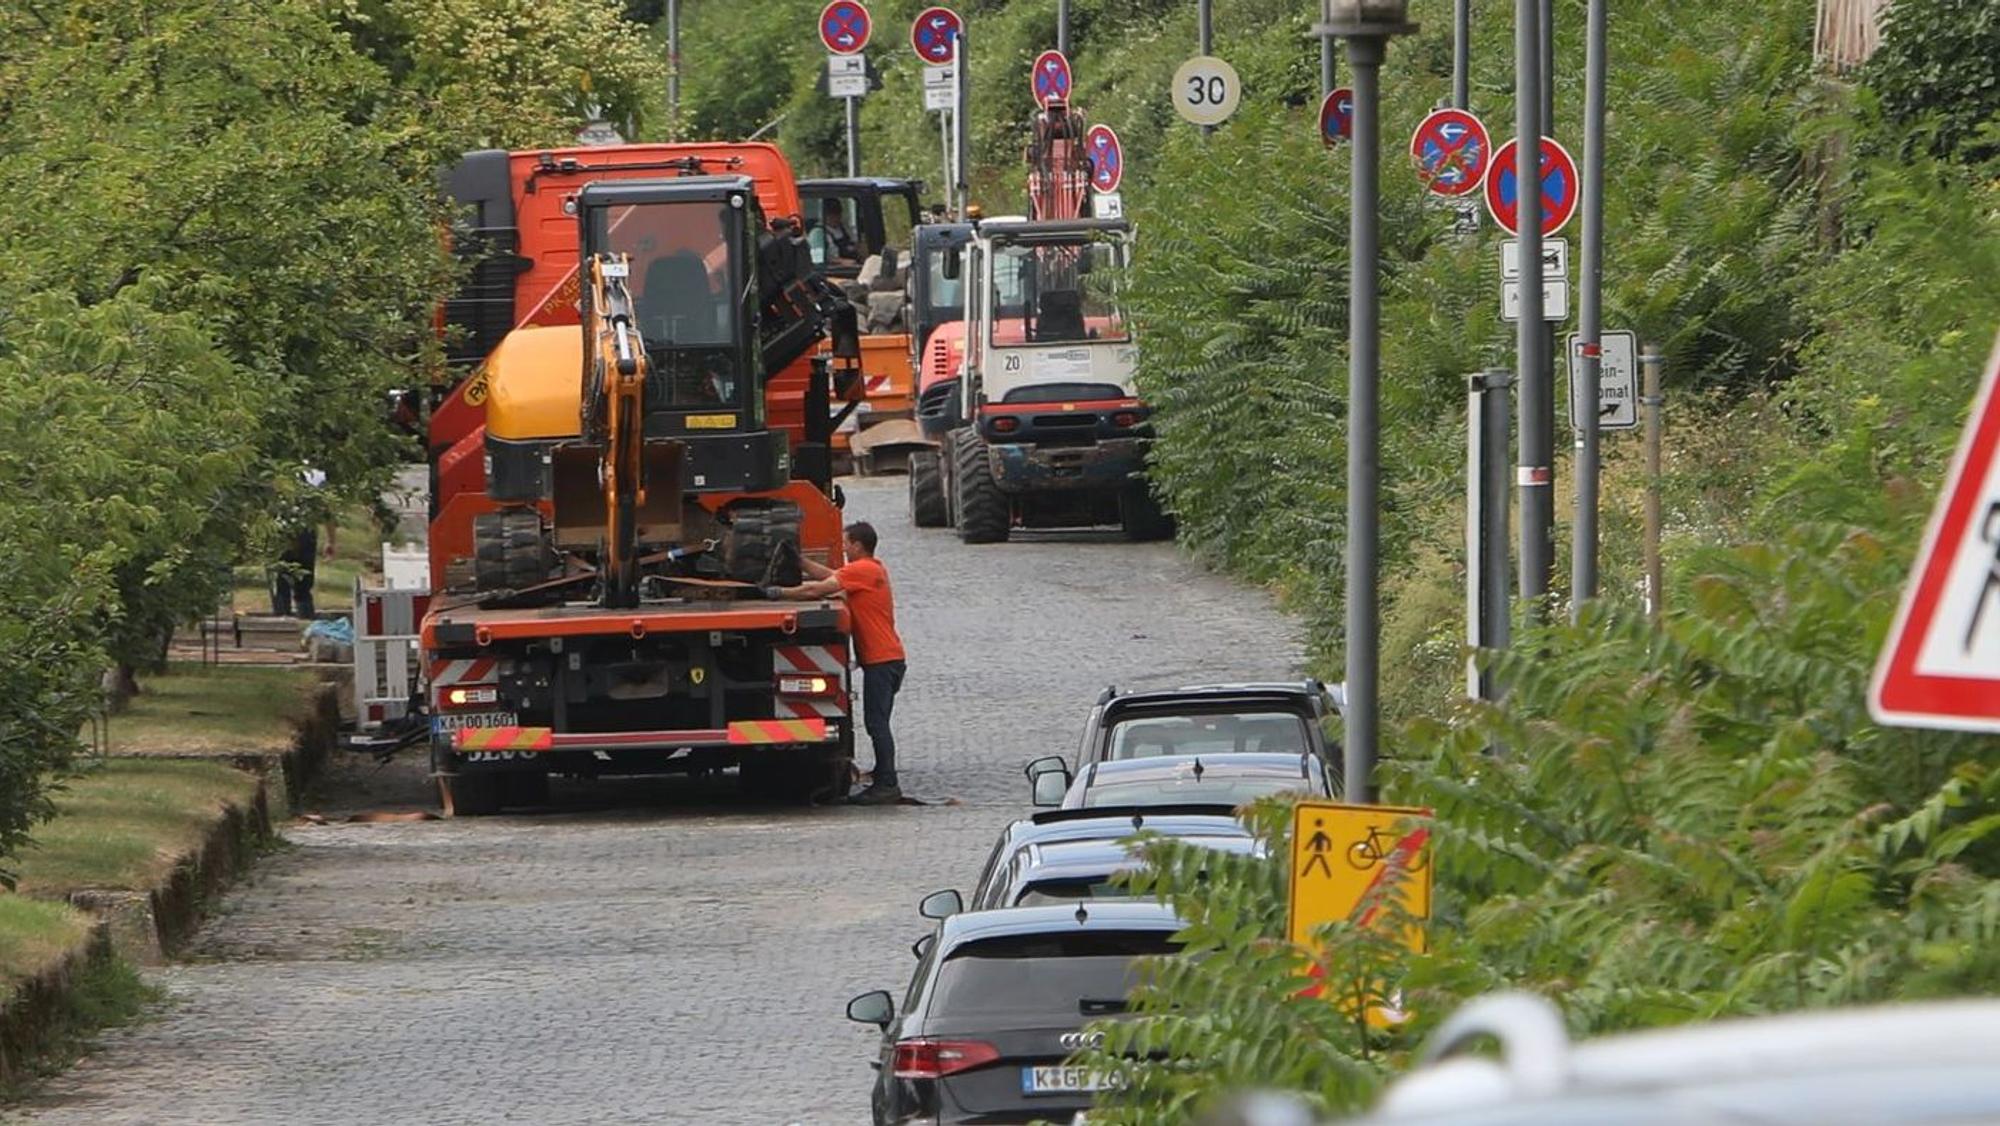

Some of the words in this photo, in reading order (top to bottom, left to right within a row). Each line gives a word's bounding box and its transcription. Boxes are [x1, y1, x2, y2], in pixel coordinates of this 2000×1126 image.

[1187, 76, 1225, 105] 30
[1005, 355, 1021, 371] 20
[440, 716, 457, 730] KA
[1036, 1069, 1049, 1088] K
